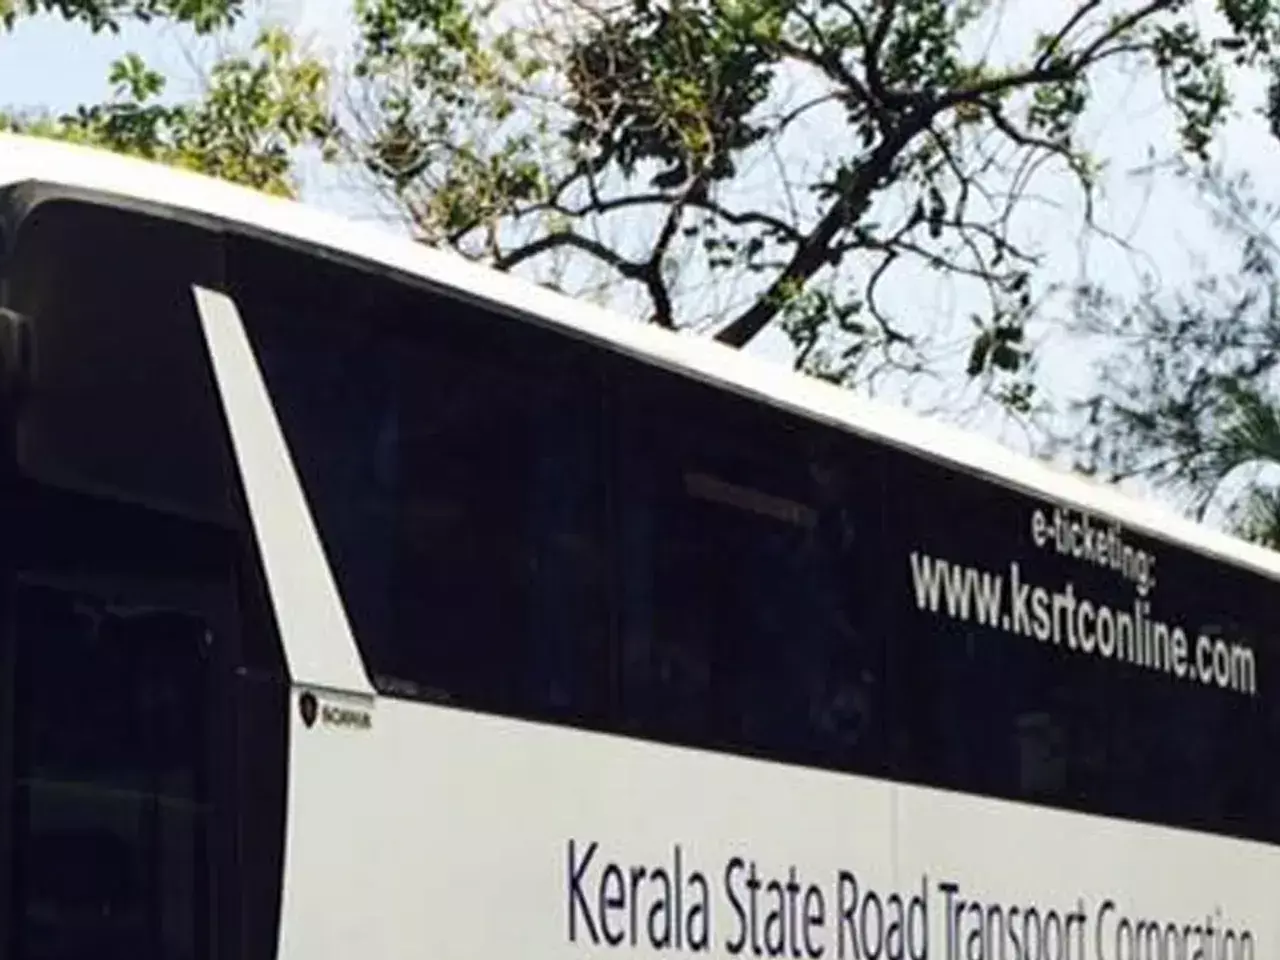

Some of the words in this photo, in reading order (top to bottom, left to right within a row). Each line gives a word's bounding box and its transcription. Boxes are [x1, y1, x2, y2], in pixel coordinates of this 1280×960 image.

[1031, 507, 1156, 597] e-ticketing:
[910, 551, 1257, 695] www.ksrtconline.com
[568, 838, 710, 953] Kerala
[724, 856, 825, 960] State
